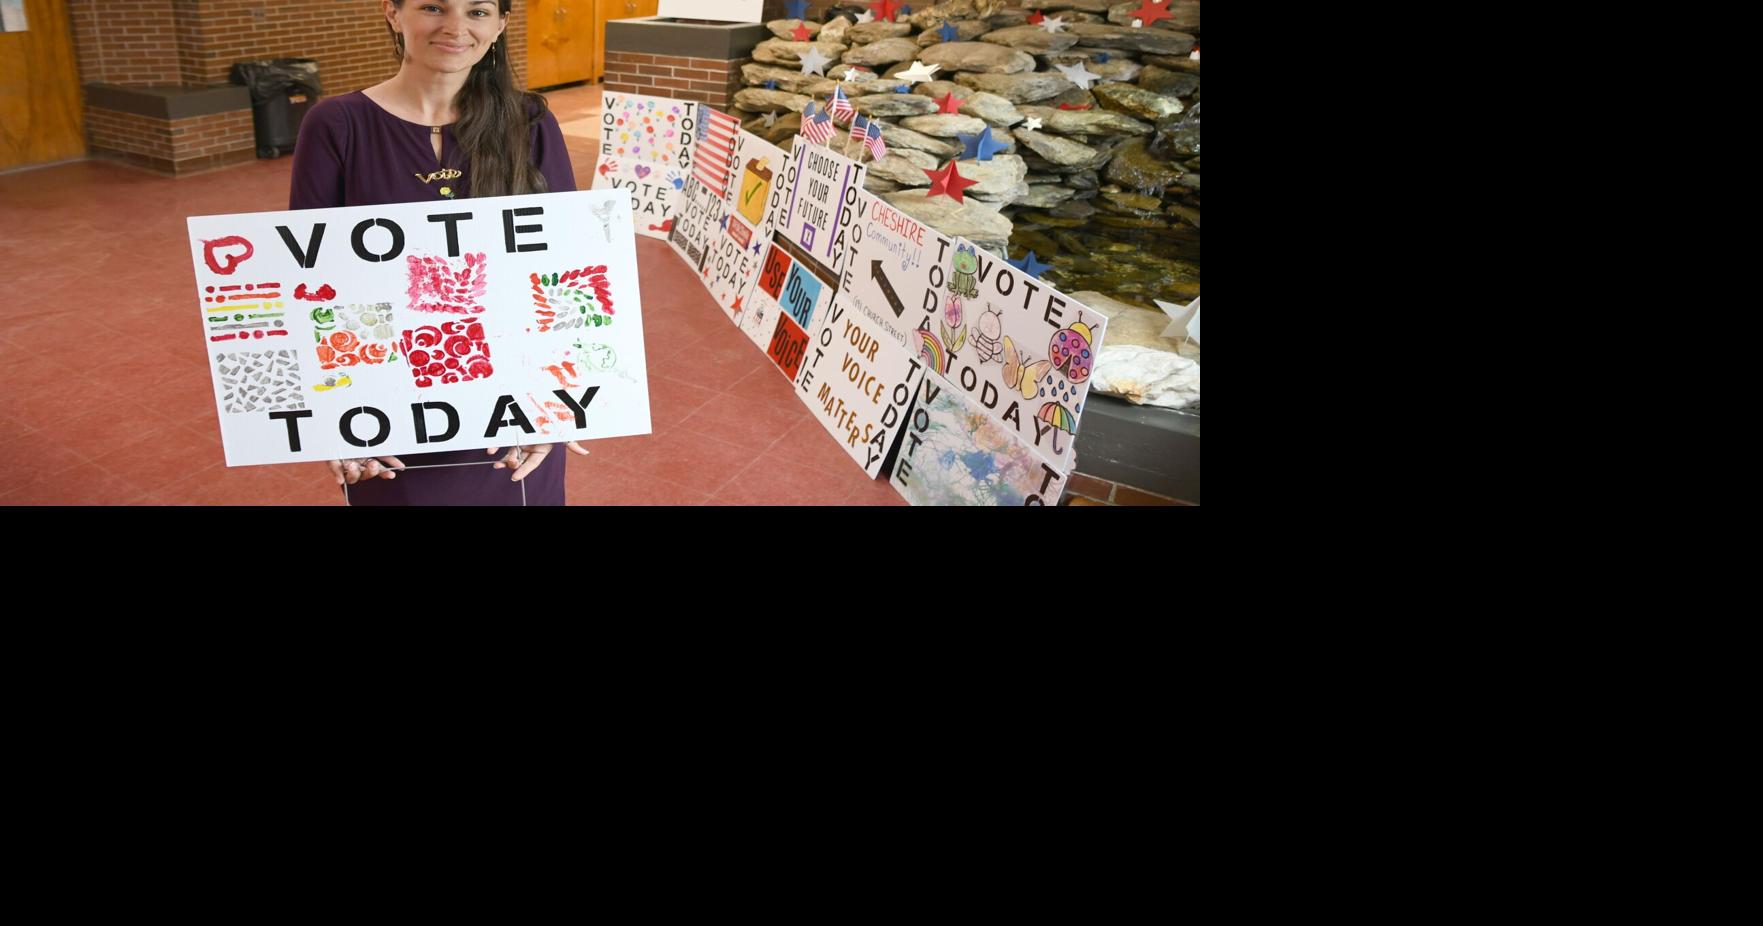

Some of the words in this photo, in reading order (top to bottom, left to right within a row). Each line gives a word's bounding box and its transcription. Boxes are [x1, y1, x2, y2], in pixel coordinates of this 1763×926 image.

[603, 97, 615, 155] VOTE
[612, 178, 667, 200] VOTE
[726, 136, 745, 203] VOTE
[779, 144, 802, 227] VOTE
[807, 151, 840, 182] CHOOSE
[809, 177, 829, 203] YOUR
[632, 198, 671, 216] DAY
[677, 213, 709, 250] TODAY
[685, 201, 710, 231] VOTE
[798, 198, 828, 231] FUTURE
[832, 164, 863, 268] TODAY
[871, 201, 926, 247] CHESHIRE
[275, 207, 548, 269] VOTE
[720, 235, 749, 273] VOTE
[843, 197, 867, 293] VOTE
[711, 249, 746, 294] TODAY
[765, 245, 786, 301] USE
[786, 263, 812, 329] YOUR
[917, 237, 950, 332] TODA
[975, 254, 1066, 330] VOTE
[800, 302, 844, 395] VOTE
[843, 318, 880, 362] YOUR
[841, 353, 885, 405] VOICE
[945, 350, 1051, 447] TODAY
[269, 386, 600, 452] TODAY
[817, 382, 871, 449] MATTERS
[864, 358, 921, 471] TODAY
[896, 377, 941, 487] VOTE
